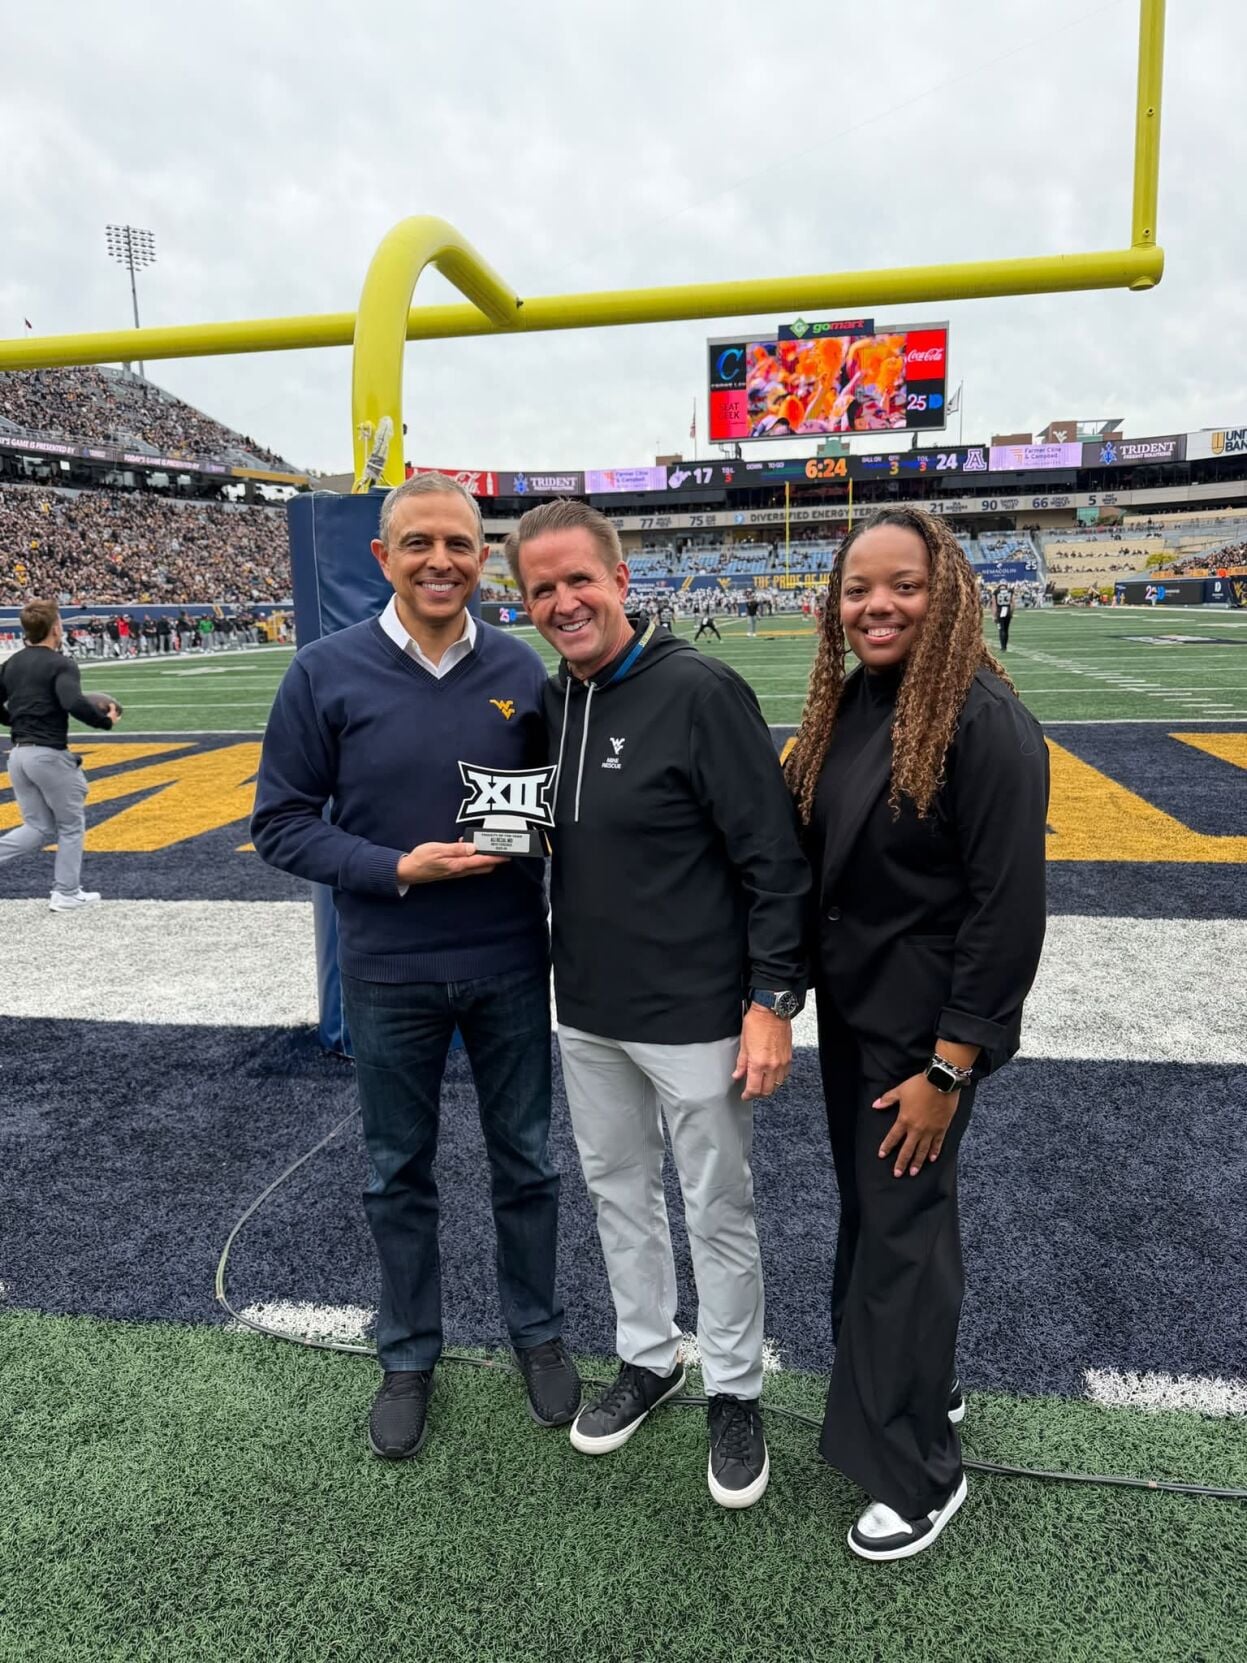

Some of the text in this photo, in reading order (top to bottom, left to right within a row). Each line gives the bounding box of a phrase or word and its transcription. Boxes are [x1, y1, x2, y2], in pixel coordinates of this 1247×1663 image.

[812, 320, 864, 333] gomart
[907, 394, 926, 410] 25
[1226, 428, 1247, 441] UNI
[11, 439, 29, 448] GAME
[36, 442, 67, 453] PRESENTED
[1120, 442, 1176, 455] TRIDENT
[936, 453, 958, 470] 24
[963, 448, 987, 472] A
[805, 458, 847, 478] 6:24
[889, 462, 899, 475] 3
[920, 463, 926, 472] 3
[530, 476, 577, 488] TRIDENT
[693, 468, 712, 484] 17
[982, 500, 997, 511] 90
[1032, 497, 1048, 508] 66
[1089, 495, 1096, 505] 5
[812, 509, 849, 519] ENERGY
[930, 502, 944, 513] 21
[640, 518, 653, 528] 77
[689, 515, 704, 526] 75
[1025, 561, 1037, 570] 25
[466, 770, 548, 818] XII
